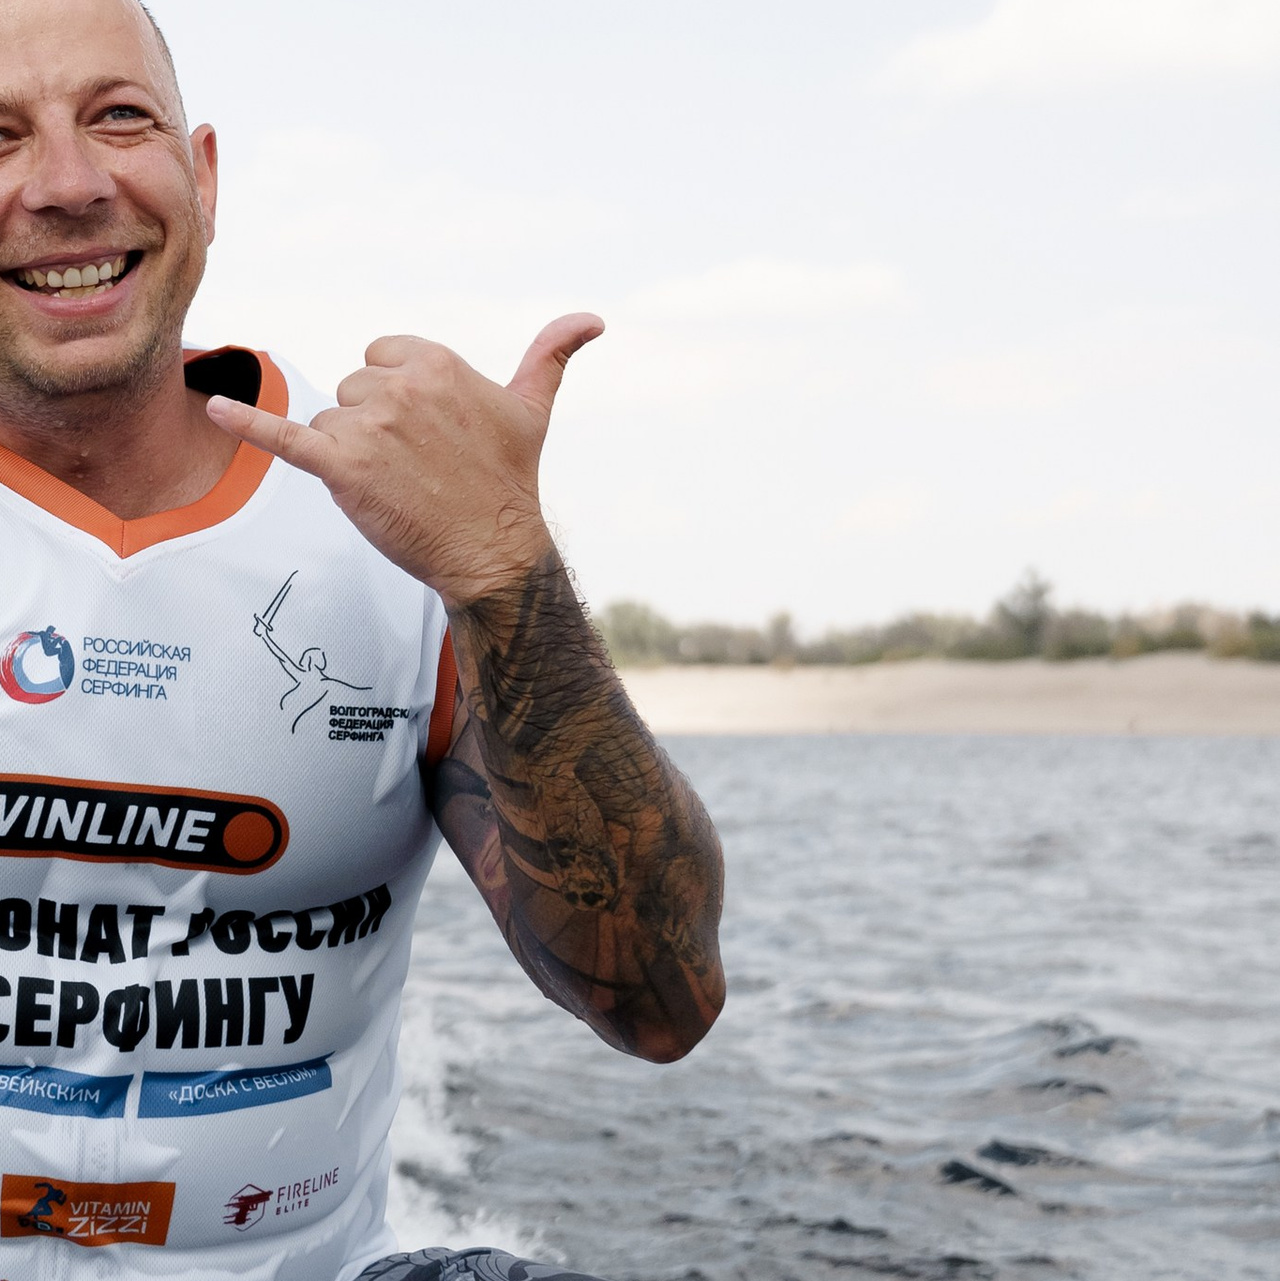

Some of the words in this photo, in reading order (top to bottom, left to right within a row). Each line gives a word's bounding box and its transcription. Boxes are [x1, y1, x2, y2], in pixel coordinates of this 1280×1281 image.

[83, 636, 191, 662] РОССИЙСКАЯ
[82, 658, 177, 681] ФЕДЕРАЦИЯ
[81, 678, 167, 700] СЕРФИНГА
[328, 717, 394, 731] ФЕДЕРАЦИЯ
[328, 730, 385, 742] СЕРФИНГА
[170, 1082, 239, 1105] «ДОСКА
[239, 1078, 253, 1092] С
[252, 1067, 317, 1090] ВЕСЛОМ»
[277, 1167, 339, 1203] FIRELINE
[70, 1201, 151, 1215] VITAMIN
[275, 1198, 309, 1215] ELITE
